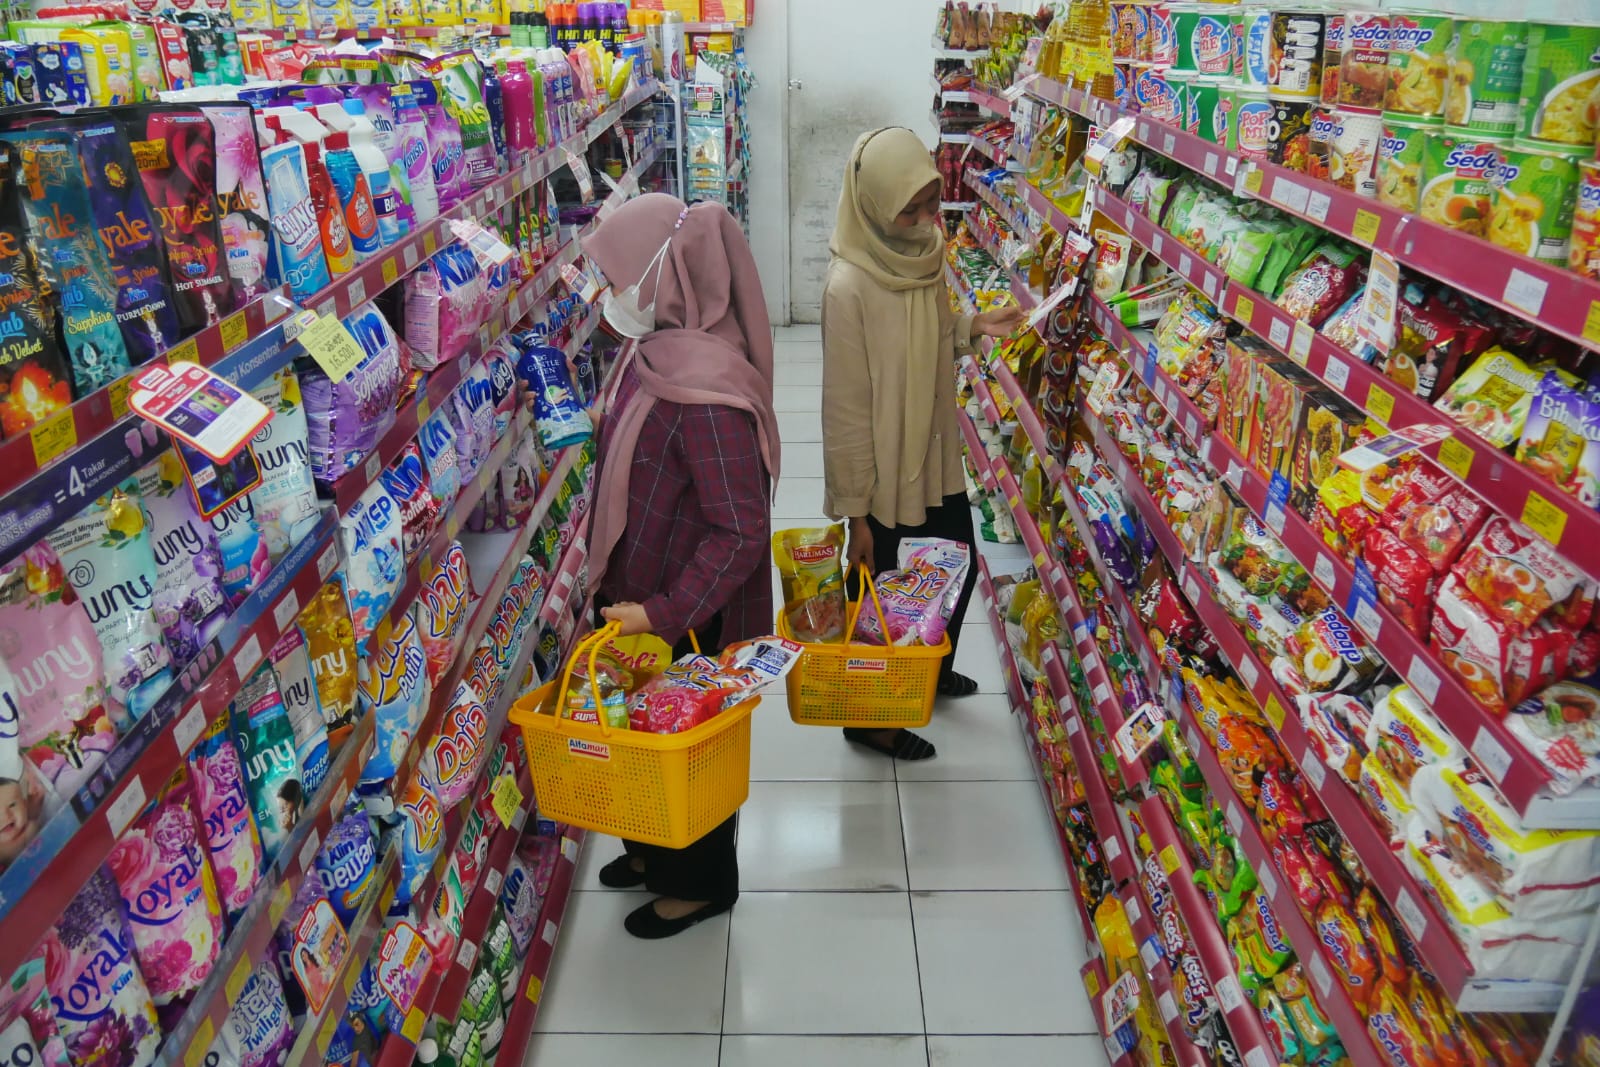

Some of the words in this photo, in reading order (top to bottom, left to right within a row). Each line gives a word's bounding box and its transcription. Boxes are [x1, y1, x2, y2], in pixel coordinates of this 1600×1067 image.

[1355, 53, 1386, 64] Goreng
[373, 114, 392, 133] clin
[1242, 110, 1267, 126] POP
[402, 138, 425, 169] Vanish
[1456, 143, 1475, 152] Mie
[229, 249, 249, 258] Klin
[176, 280, 194, 292] HOT
[196, 275, 223, 289] SUMMER
[67, 311, 113, 335] Sapphire
[117, 307, 146, 323] PURPLE
[14, 338, 44, 359] Velvet
[527, 359, 560, 372] GENTLE
[459, 377, 492, 414] Klin
[69, 464, 85, 498] 4
[82, 458, 106, 479] Takar
[381, 453, 424, 508] Klin
[77, 519, 105, 537] Minyak
[258, 563, 287, 602] Pewangi
[419, 546, 470, 637] Daia
[511, 564, 542, 620] Daia
[782, 640, 799, 651] NEW
[1324, 604, 1362, 663] Sedaap
[399, 646, 424, 701] Putih
[848, 659, 885, 668] Alfamart
[434, 704, 488, 785] Daia
[569, 739, 609, 754] Alfamart
[1389, 720, 1425, 758] Sedaap
[1453, 805, 1495, 852] Sedaap
[329, 841, 355, 867] Klin
[502, 866, 525, 914] Klin
[1256, 895, 1291, 953] Sedaap
[111, 968, 134, 996] Klin
[245, 996, 285, 1051] Twilight
